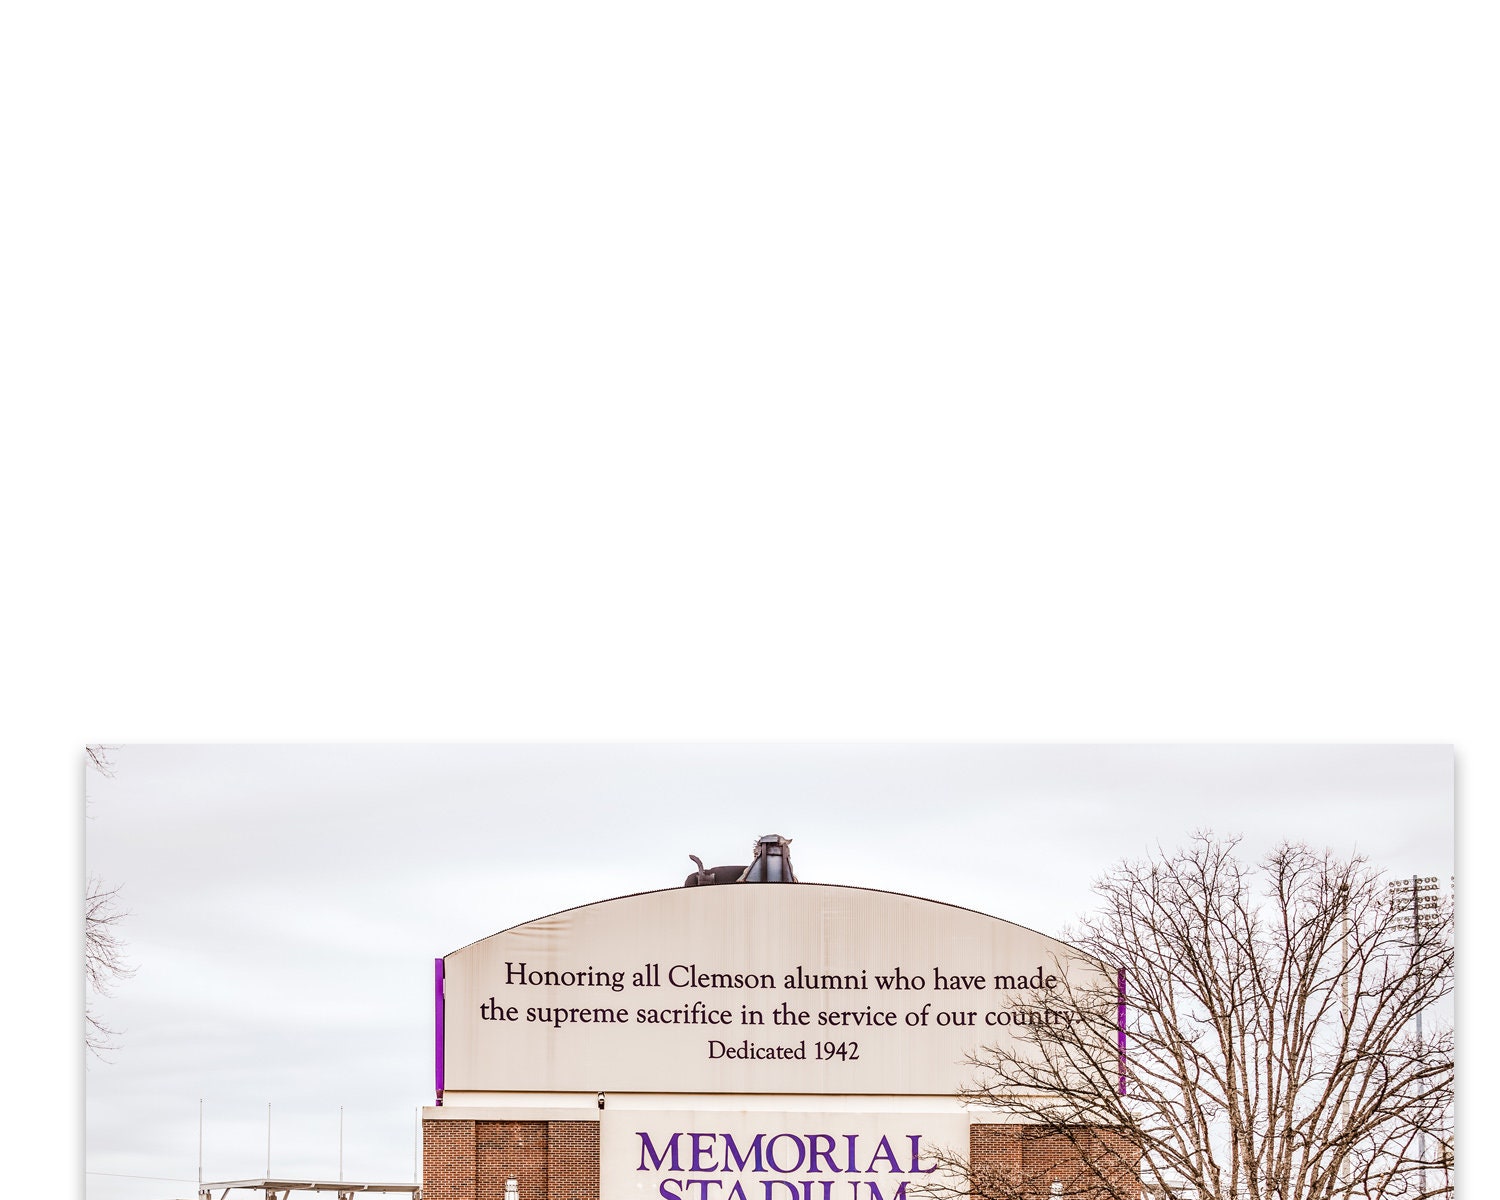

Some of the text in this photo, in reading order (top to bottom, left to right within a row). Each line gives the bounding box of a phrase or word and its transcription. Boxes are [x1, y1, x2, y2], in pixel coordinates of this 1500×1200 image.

[504, 961, 1058, 993] Honoring all Clemson alumni who have made
[479, 998, 519, 1022] the
[526, 1007, 629, 1028] supreme
[636, 1000, 733, 1026] sacrifice
[740, 1004, 765, 1025] in
[772, 1001, 811, 1026] the
[818, 1005, 898, 1027] service
[904, 1002, 932, 1027] of
[936, 1011, 978, 1027] our
[707, 1039, 860, 1062] Dedicated 1942
[635, 1132, 938, 1173] MEMORIAL
